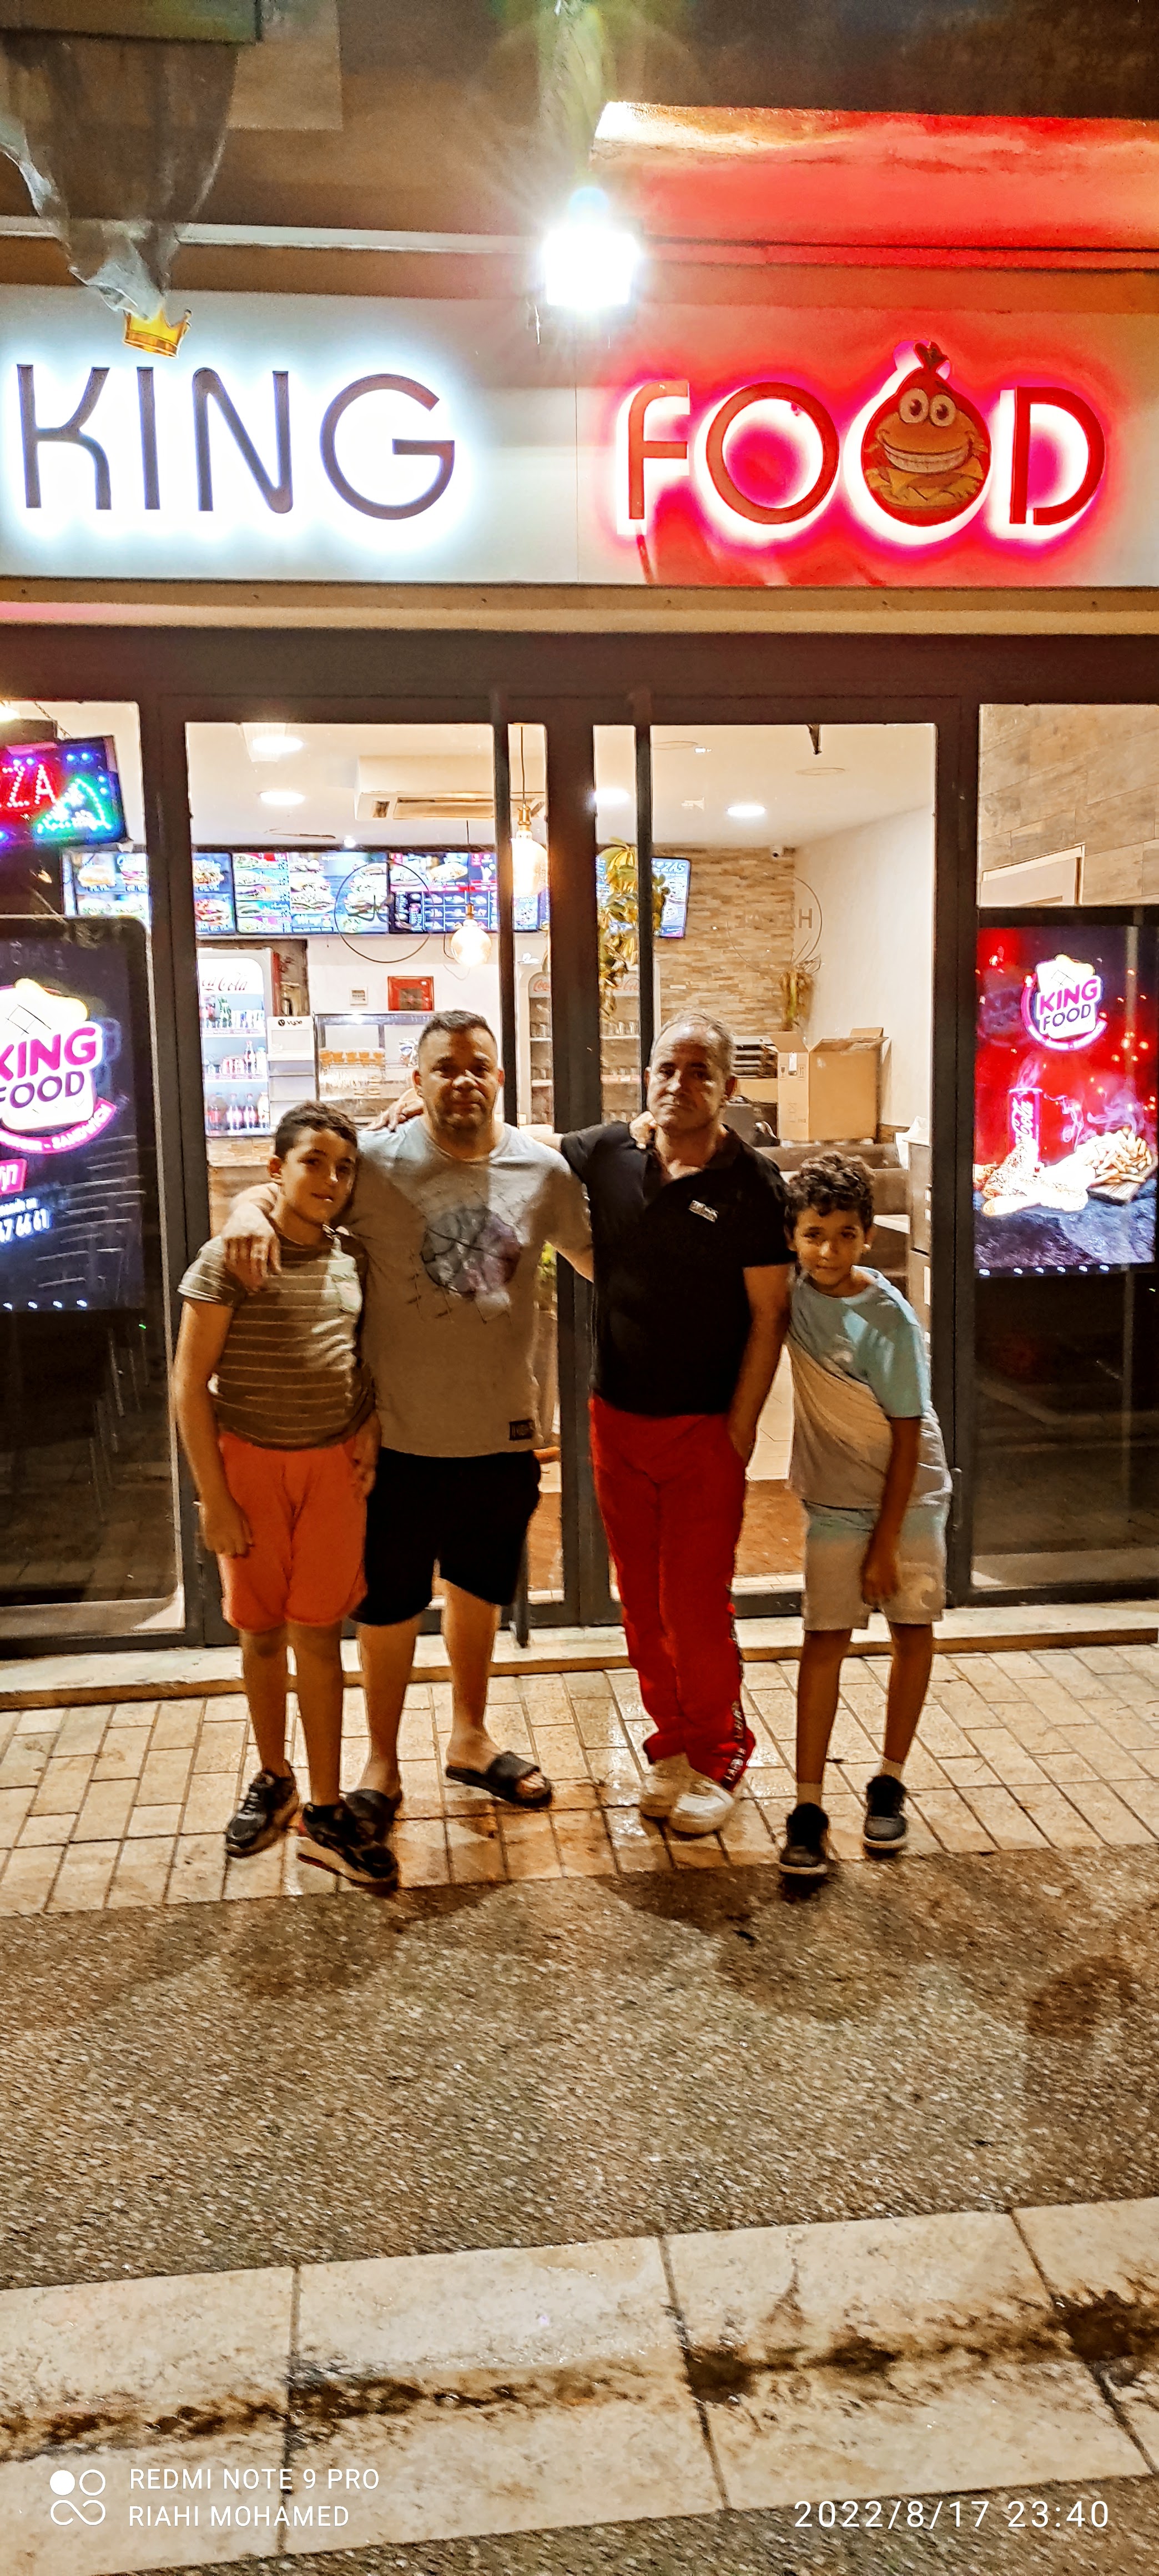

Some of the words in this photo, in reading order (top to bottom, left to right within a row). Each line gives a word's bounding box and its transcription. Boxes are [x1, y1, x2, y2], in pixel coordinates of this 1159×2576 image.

[17, 364, 455, 520] KING
[628, 340, 1105, 526] FOOD
[0, 764, 57, 808] ZA
[652, 861, 687, 873] ZZAS
[1040, 979, 1097, 1015] KING
[1044, 1004, 1091, 1031] FOOD
